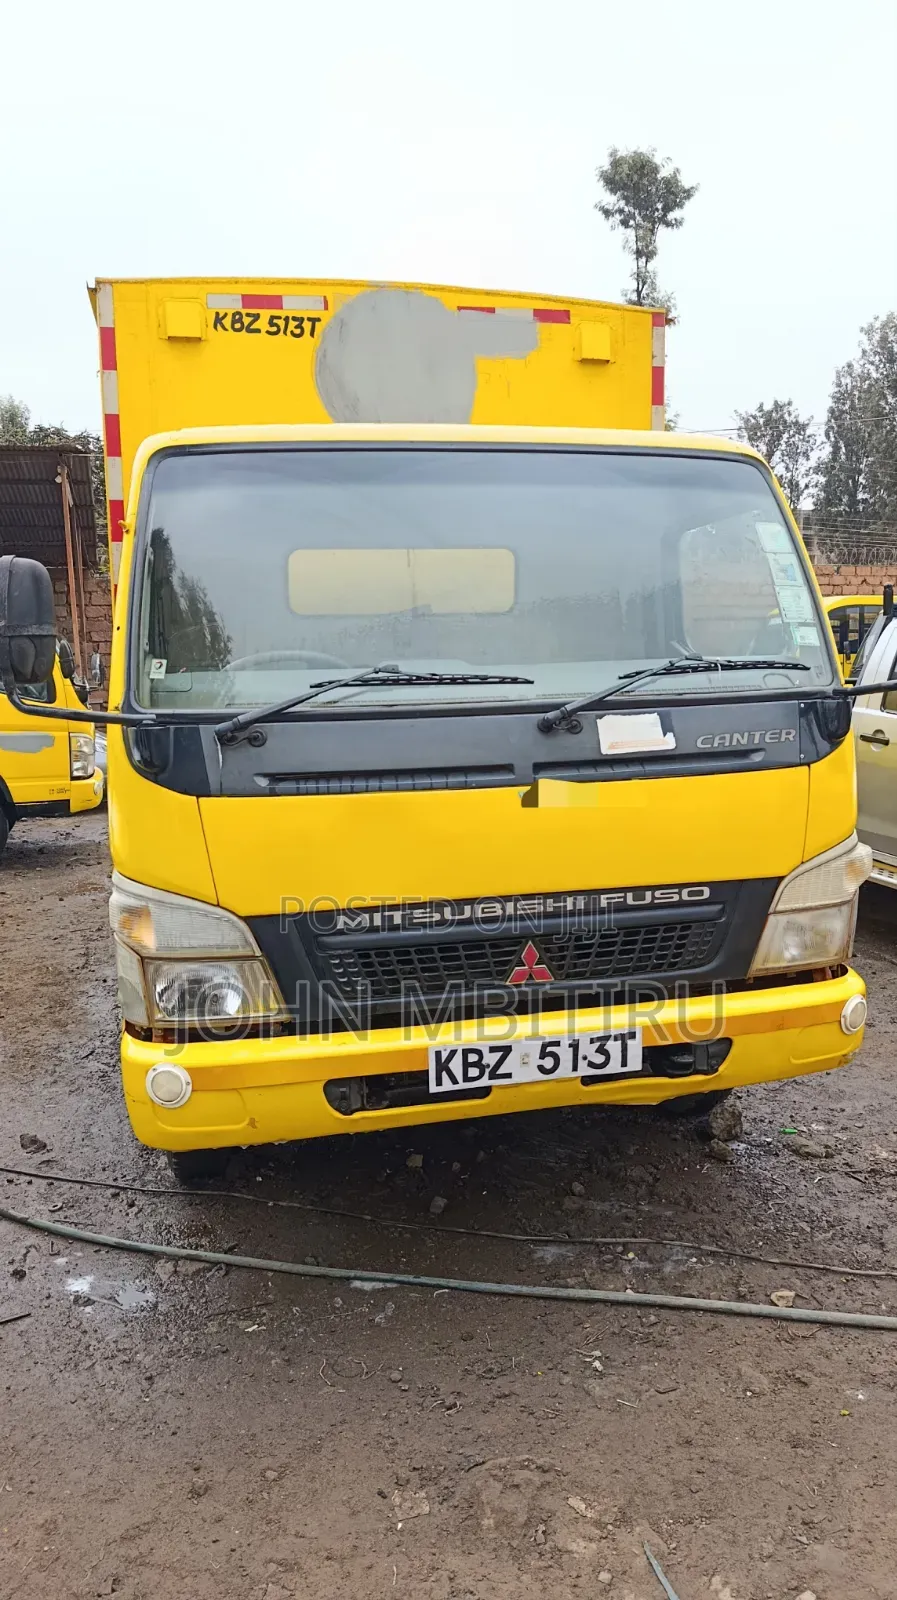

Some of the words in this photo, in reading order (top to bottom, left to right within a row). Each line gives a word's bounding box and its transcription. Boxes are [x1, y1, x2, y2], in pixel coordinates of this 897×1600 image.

[213, 311, 261, 334] KBZ
[265, 315, 321, 338] 513T
[696, 729, 797, 749] CANTER
[336, 895, 585, 929] MITSUBISHI
[600, 886, 710, 908] FUSO
[434, 1044, 513, 1087] KBZ
[536, 1031, 637, 1075] 513T
